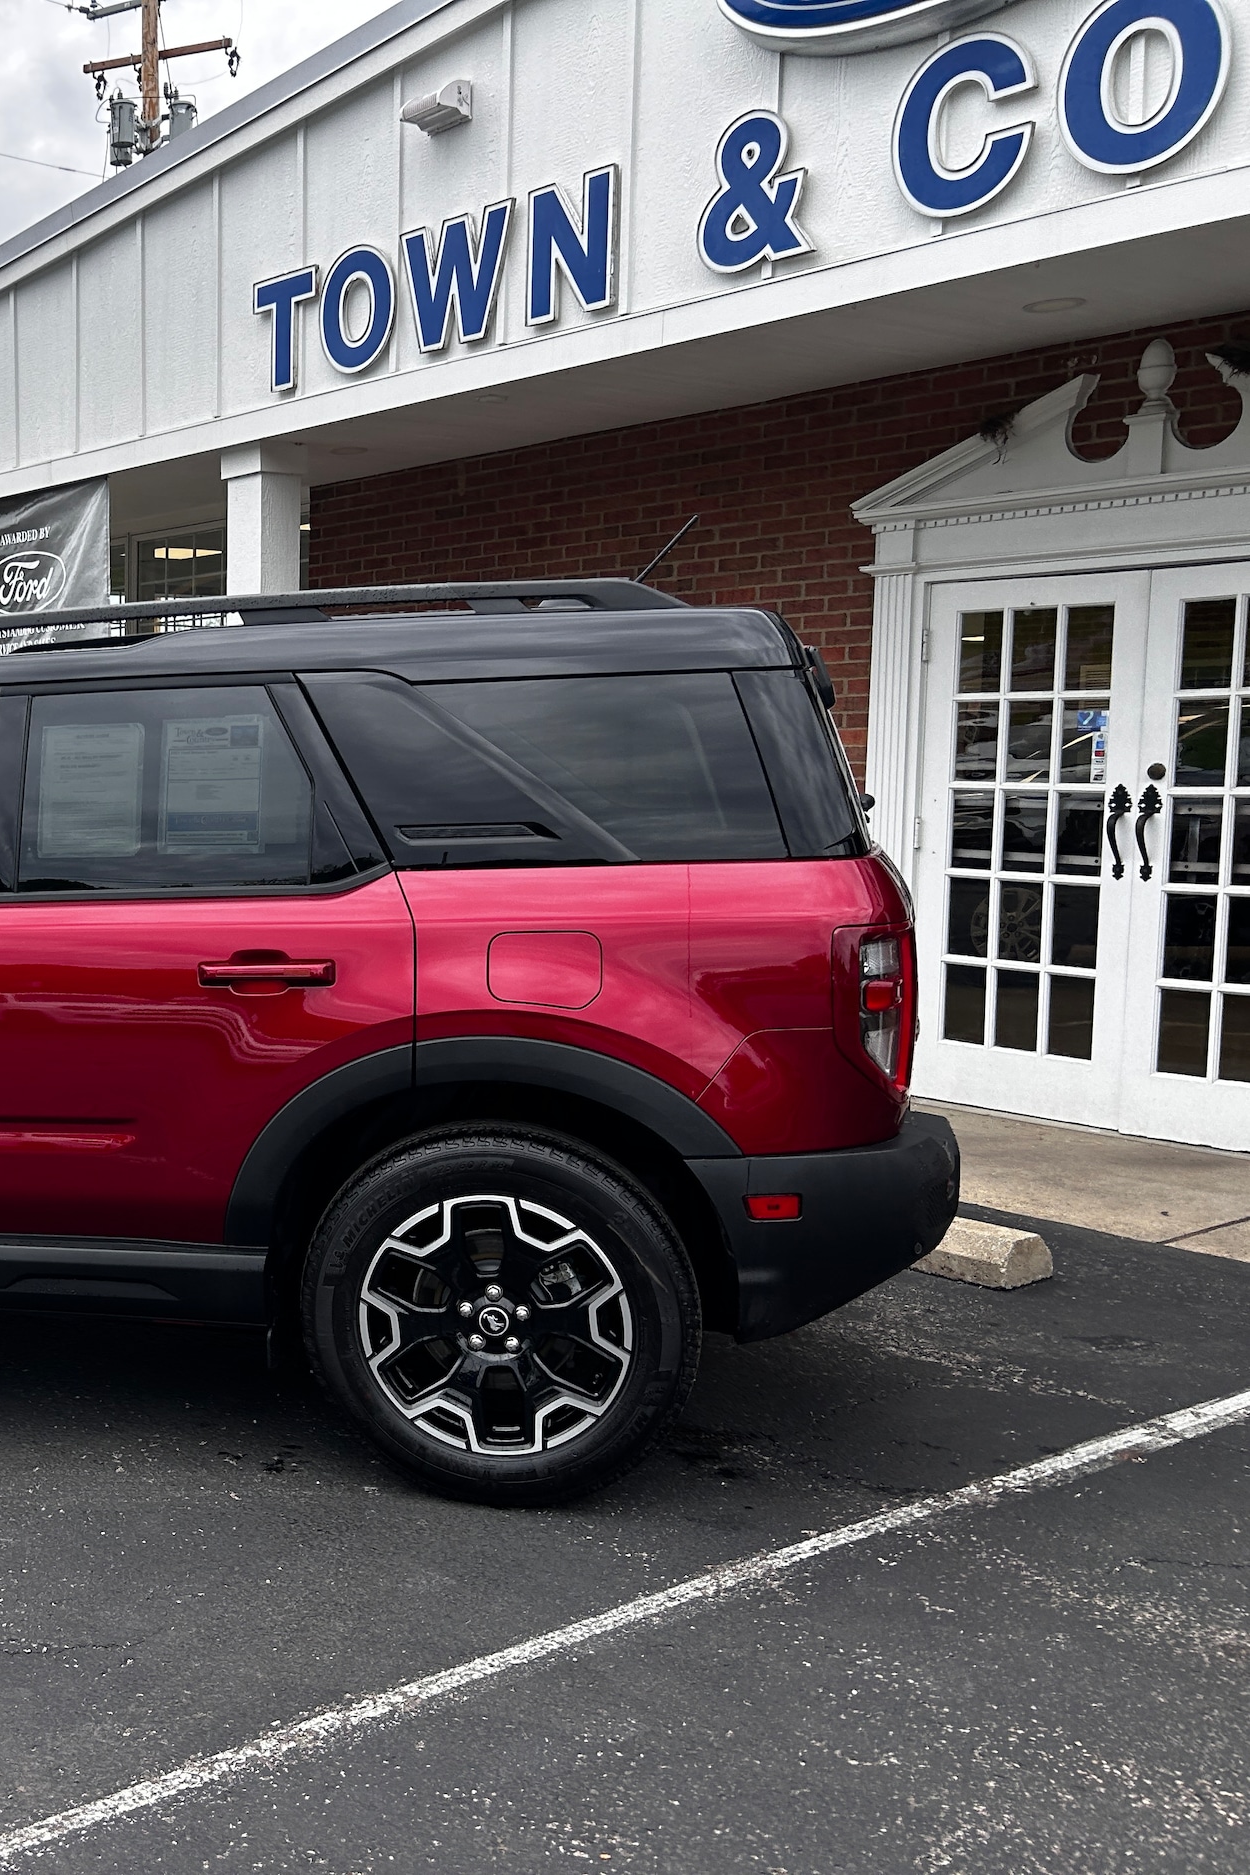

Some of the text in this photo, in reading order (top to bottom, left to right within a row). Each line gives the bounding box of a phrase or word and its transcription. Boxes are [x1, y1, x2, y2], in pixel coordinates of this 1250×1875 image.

[253, 163, 619, 393] TOWN
[697, 108, 816, 276] &
[0, 525, 51, 546] AWARDED BY
